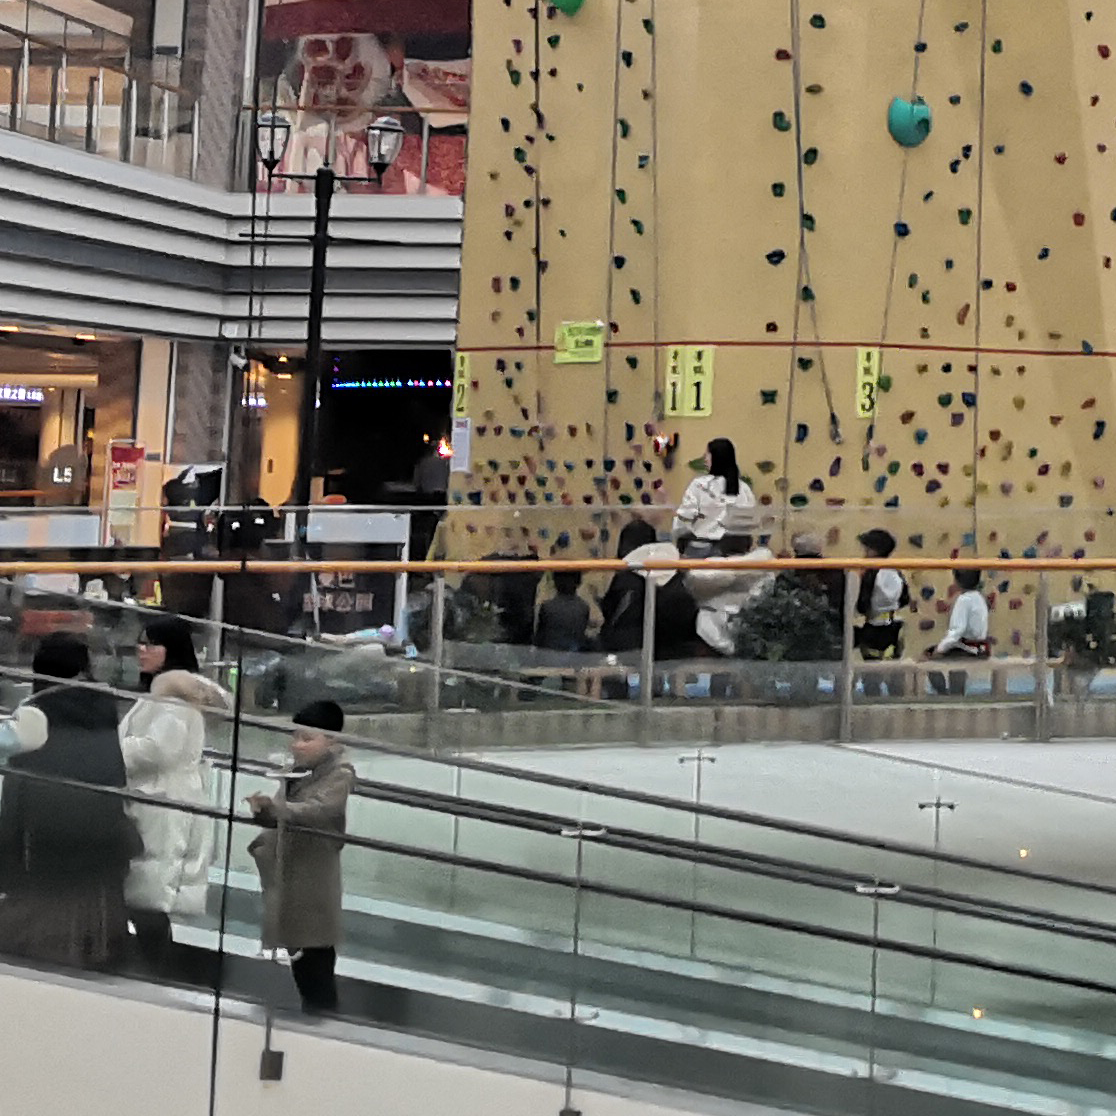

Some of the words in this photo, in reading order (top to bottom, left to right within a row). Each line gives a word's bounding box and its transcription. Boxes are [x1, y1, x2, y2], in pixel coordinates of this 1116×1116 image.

[456, 383, 465, 412] 2
[692, 381, 705, 411] 1
[861, 382, 875, 412] 3
[53, 466, 72, 483] L5
